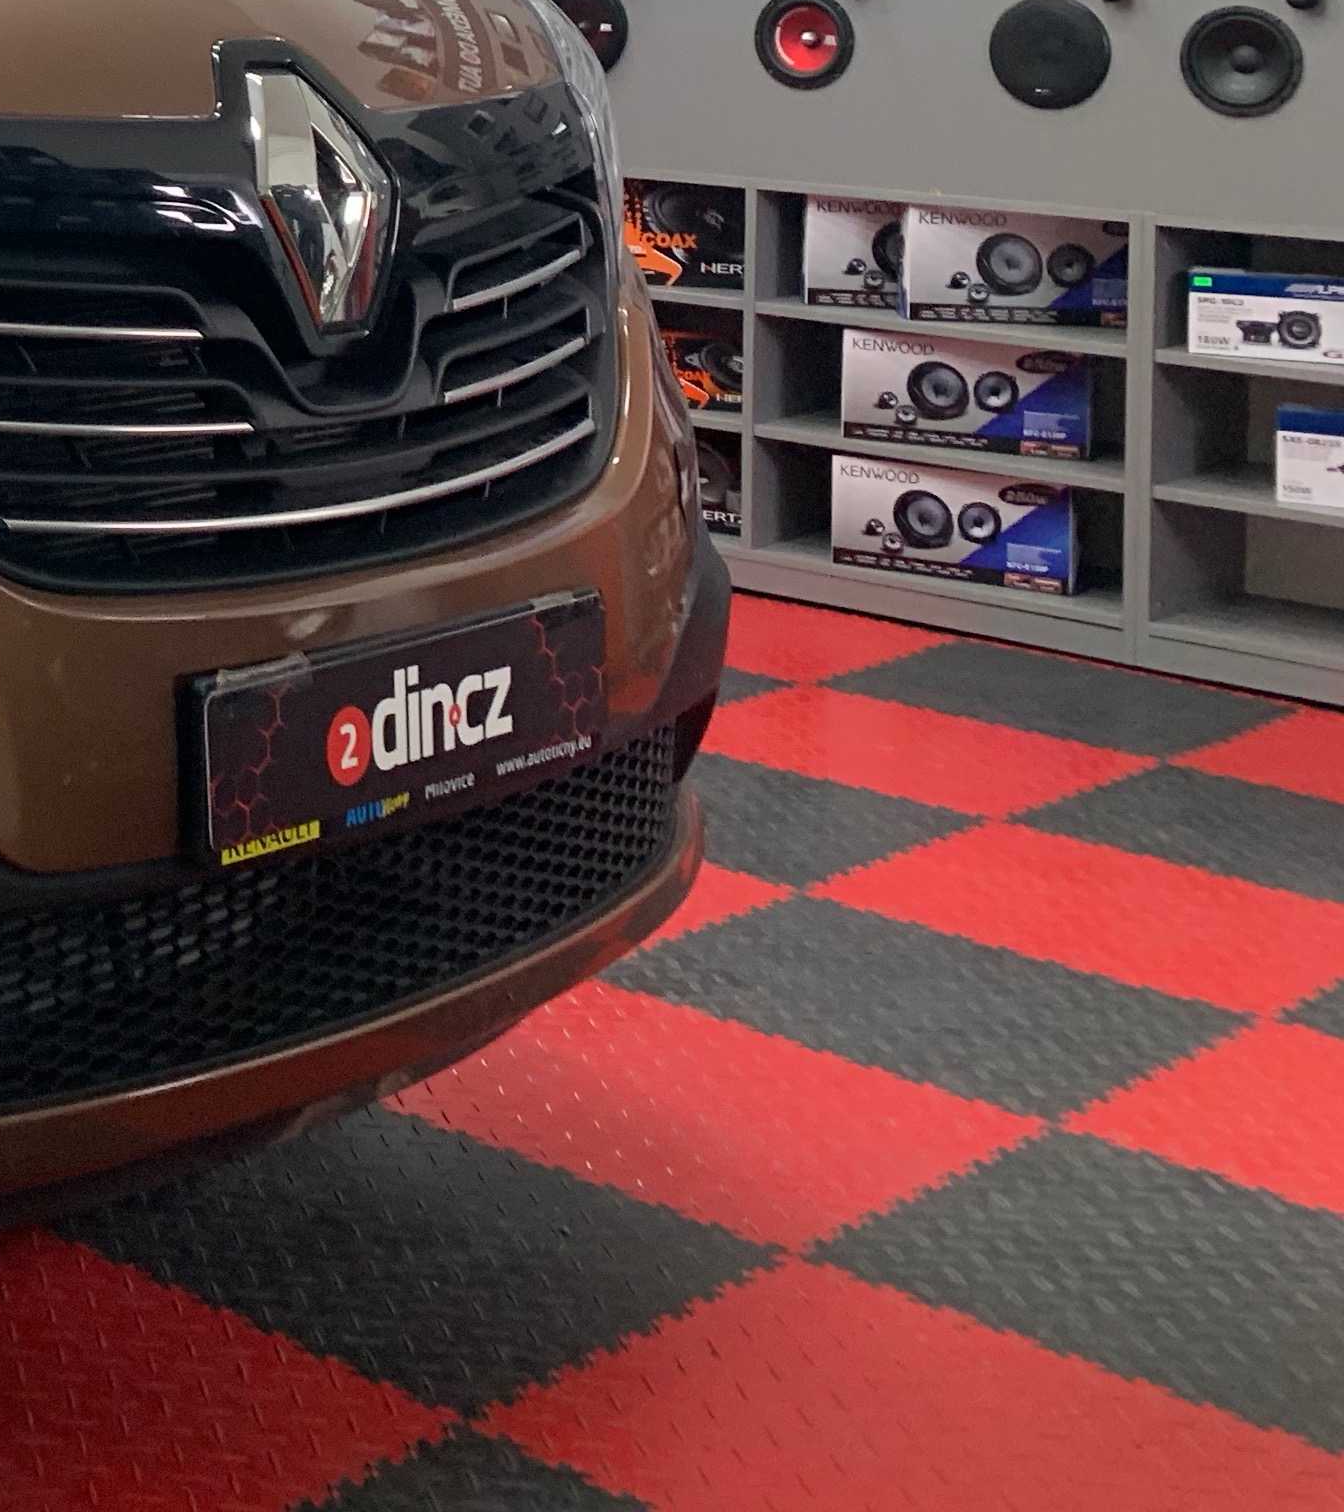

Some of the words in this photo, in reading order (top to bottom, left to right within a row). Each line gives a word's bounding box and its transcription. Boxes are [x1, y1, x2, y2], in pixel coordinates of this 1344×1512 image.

[918, 211, 1008, 228] KENWOOD
[641, 233, 697, 249] COAX
[700, 262, 744, 275] HER
[851, 337, 935, 357] KENWOOD
[839, 463, 921, 485] KENWOOD
